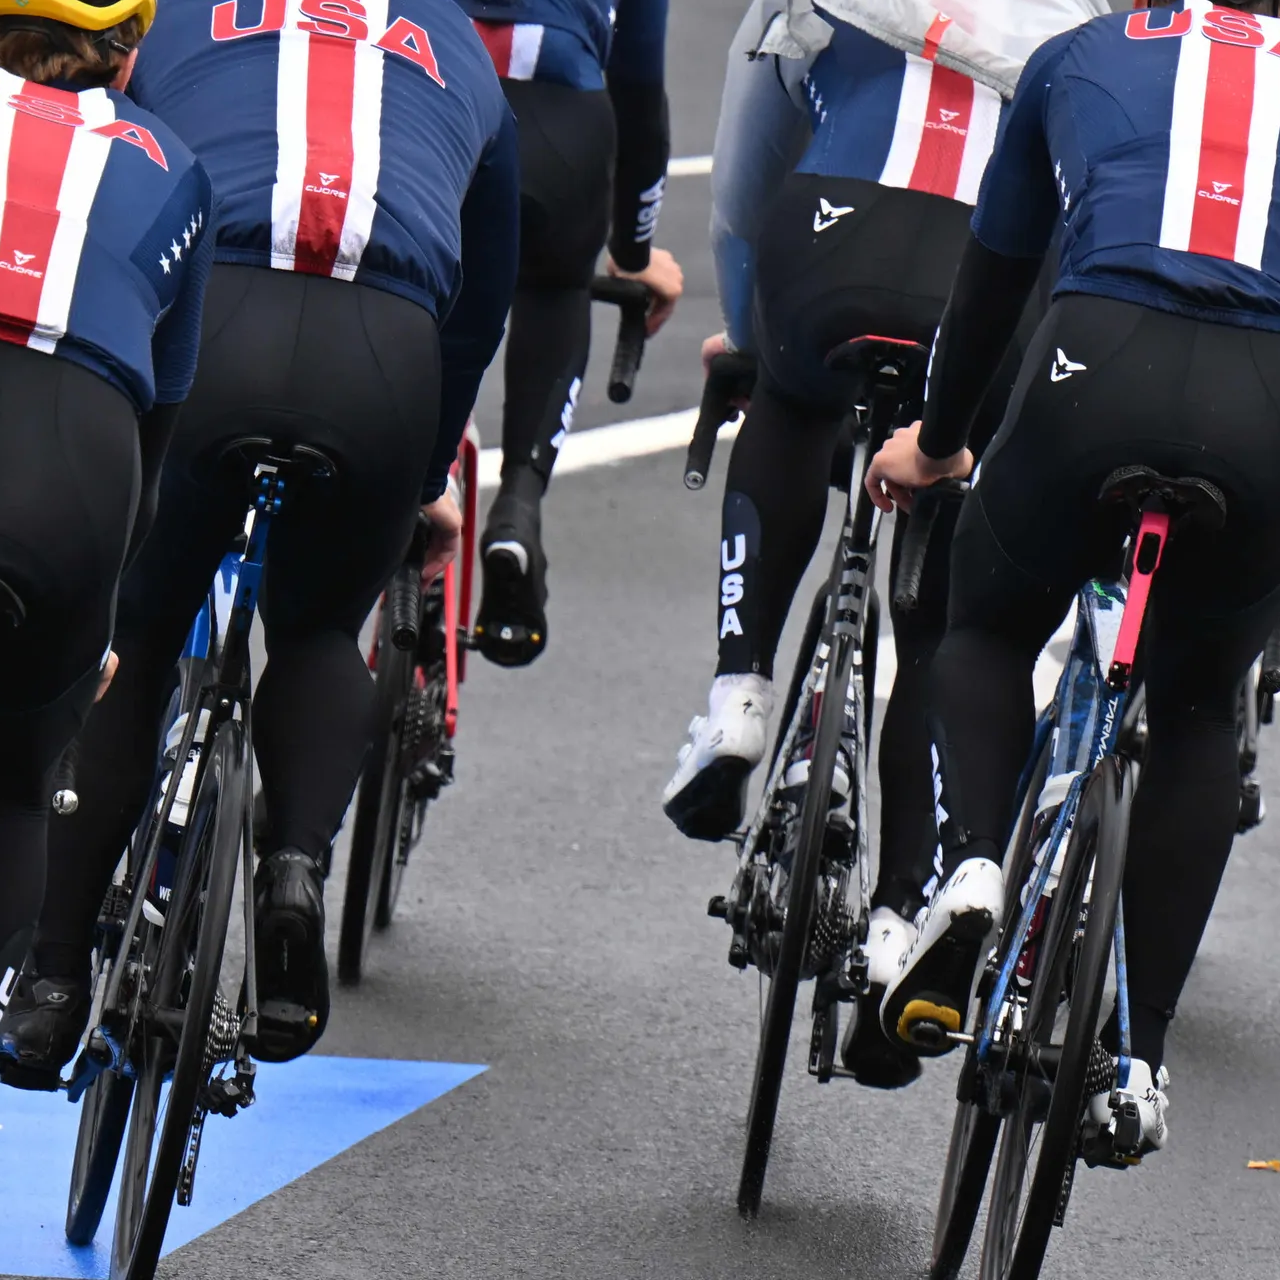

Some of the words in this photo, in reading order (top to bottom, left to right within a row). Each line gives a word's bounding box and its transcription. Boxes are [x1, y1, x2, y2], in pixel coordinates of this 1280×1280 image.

[304, 184, 348, 200] CUORE
[1198, 190, 1241, 206] CUORE
[721, 533, 746, 639] USA
